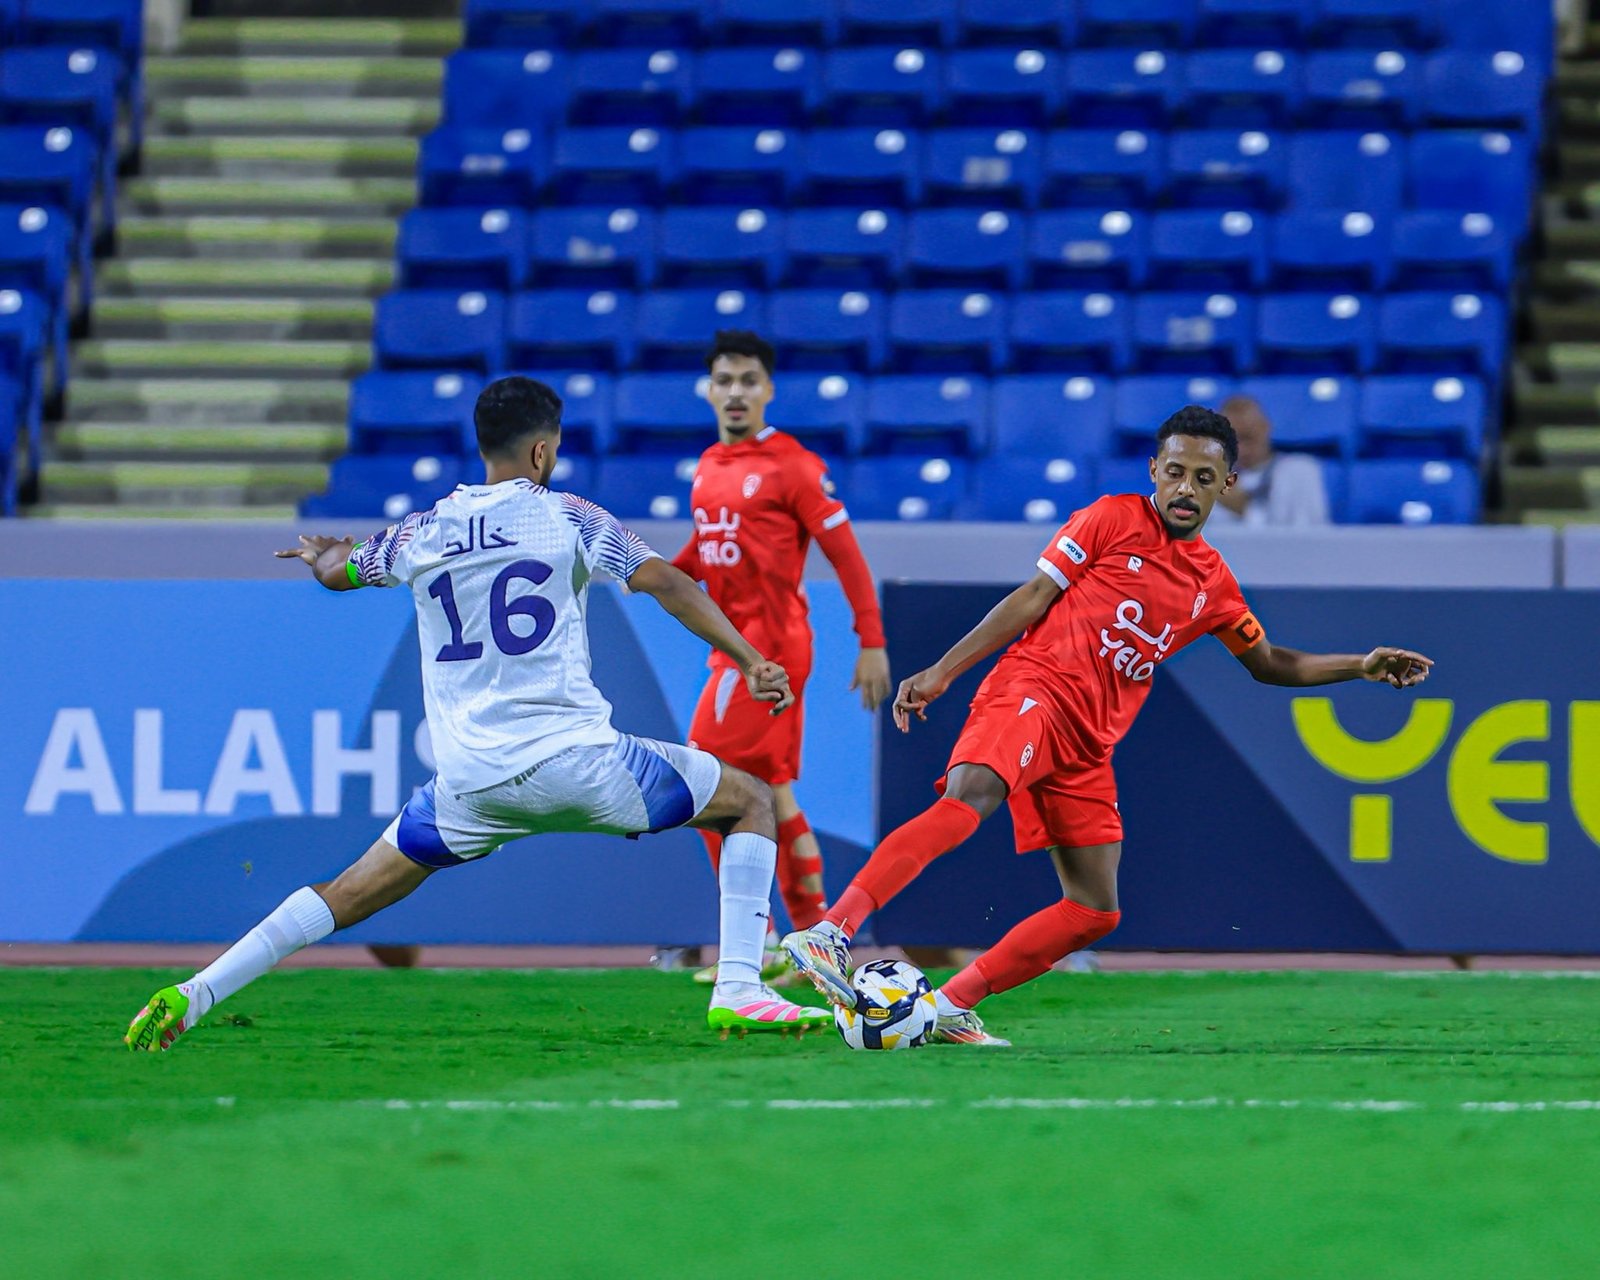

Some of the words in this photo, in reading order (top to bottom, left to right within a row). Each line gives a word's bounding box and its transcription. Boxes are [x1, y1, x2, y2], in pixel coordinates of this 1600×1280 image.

[441, 515, 518, 558] خالد
[427, 559, 556, 662] 16
[1236, 618, 1260, 643] C
[1098, 628, 1155, 681] YELO
